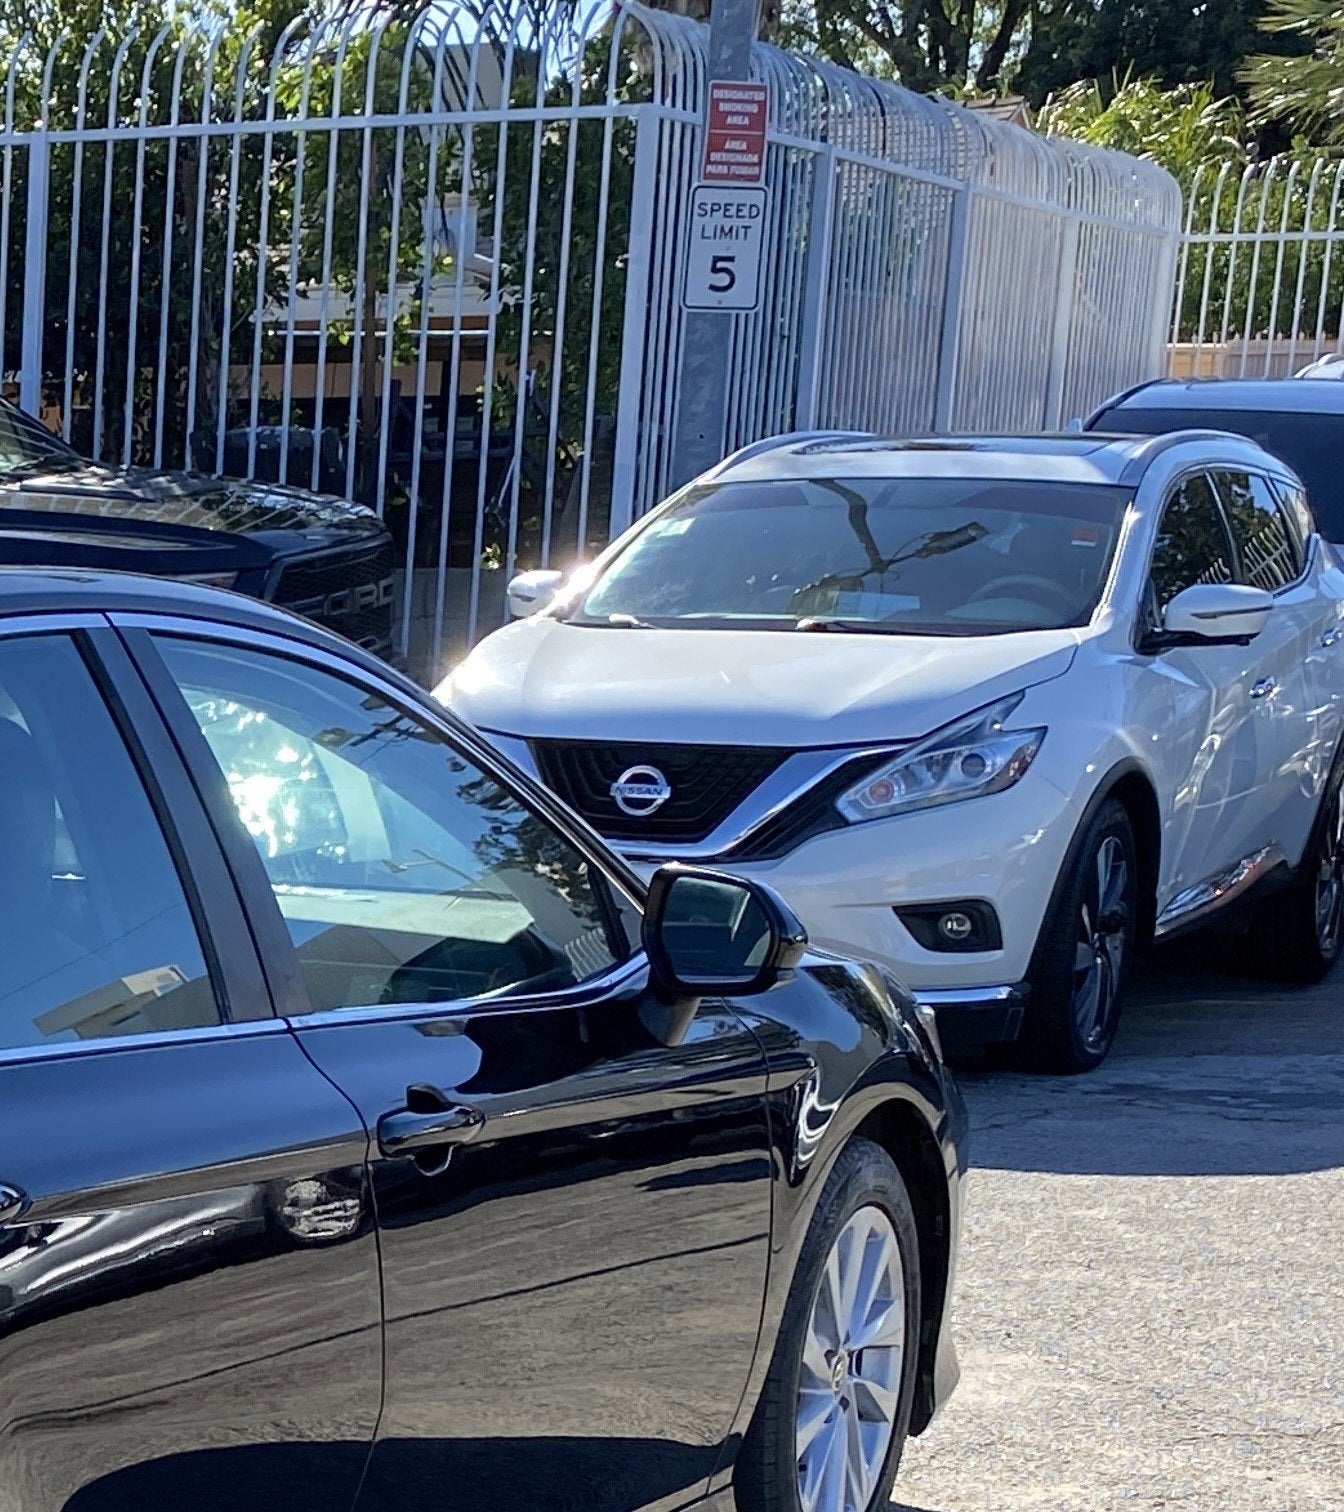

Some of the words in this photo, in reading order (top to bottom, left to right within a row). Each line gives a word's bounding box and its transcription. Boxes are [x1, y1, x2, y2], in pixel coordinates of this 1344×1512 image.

[726, 114, 750, 125] AREA
[696, 202, 761, 219] SPEED
[700, 224, 752, 241] LIMIT
[708, 255, 736, 293] 5
